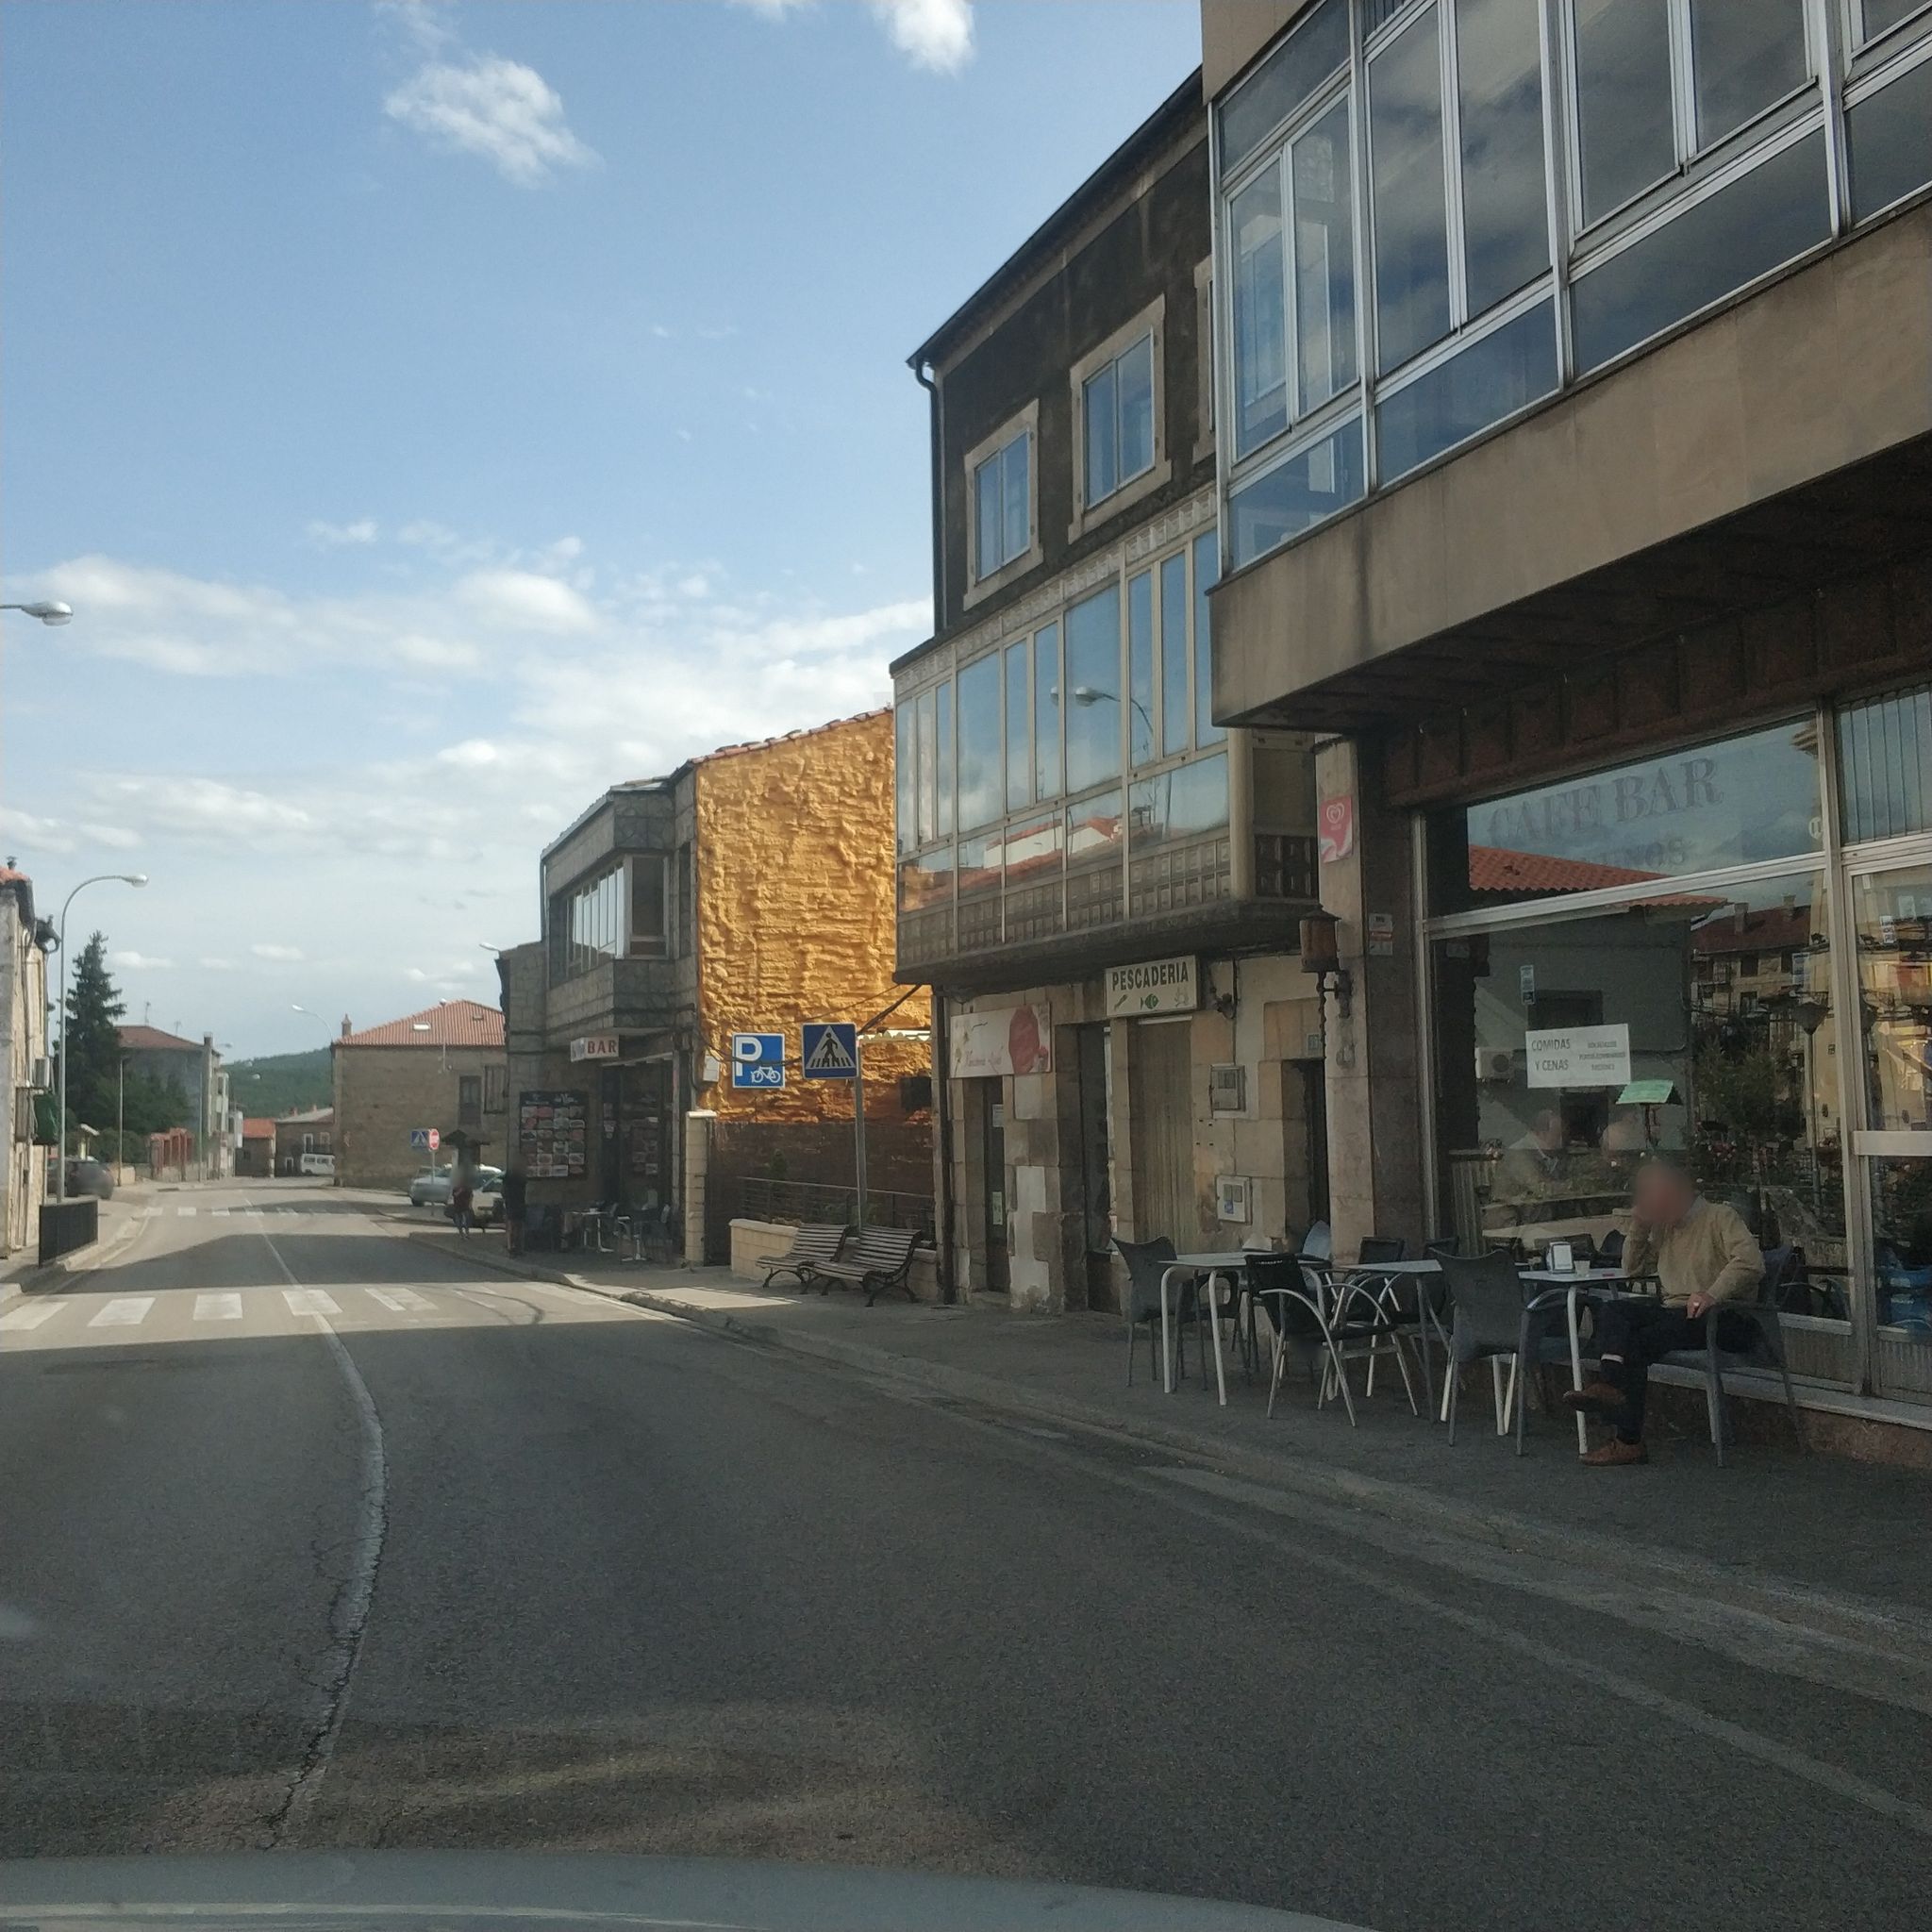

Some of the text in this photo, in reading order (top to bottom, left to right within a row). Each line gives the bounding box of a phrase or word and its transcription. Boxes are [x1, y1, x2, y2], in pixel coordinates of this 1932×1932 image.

[1612, 758, 1724, 822] BAR
[1112, 961, 1189, 991] PESCADERIA
[587, 1040, 617, 1055] BAR
[736, 1037, 762, 1076] P
[1531, 1039, 1571, 1052] COMIDAS
[1534, 1058, 1569, 1072] Y CENAS
